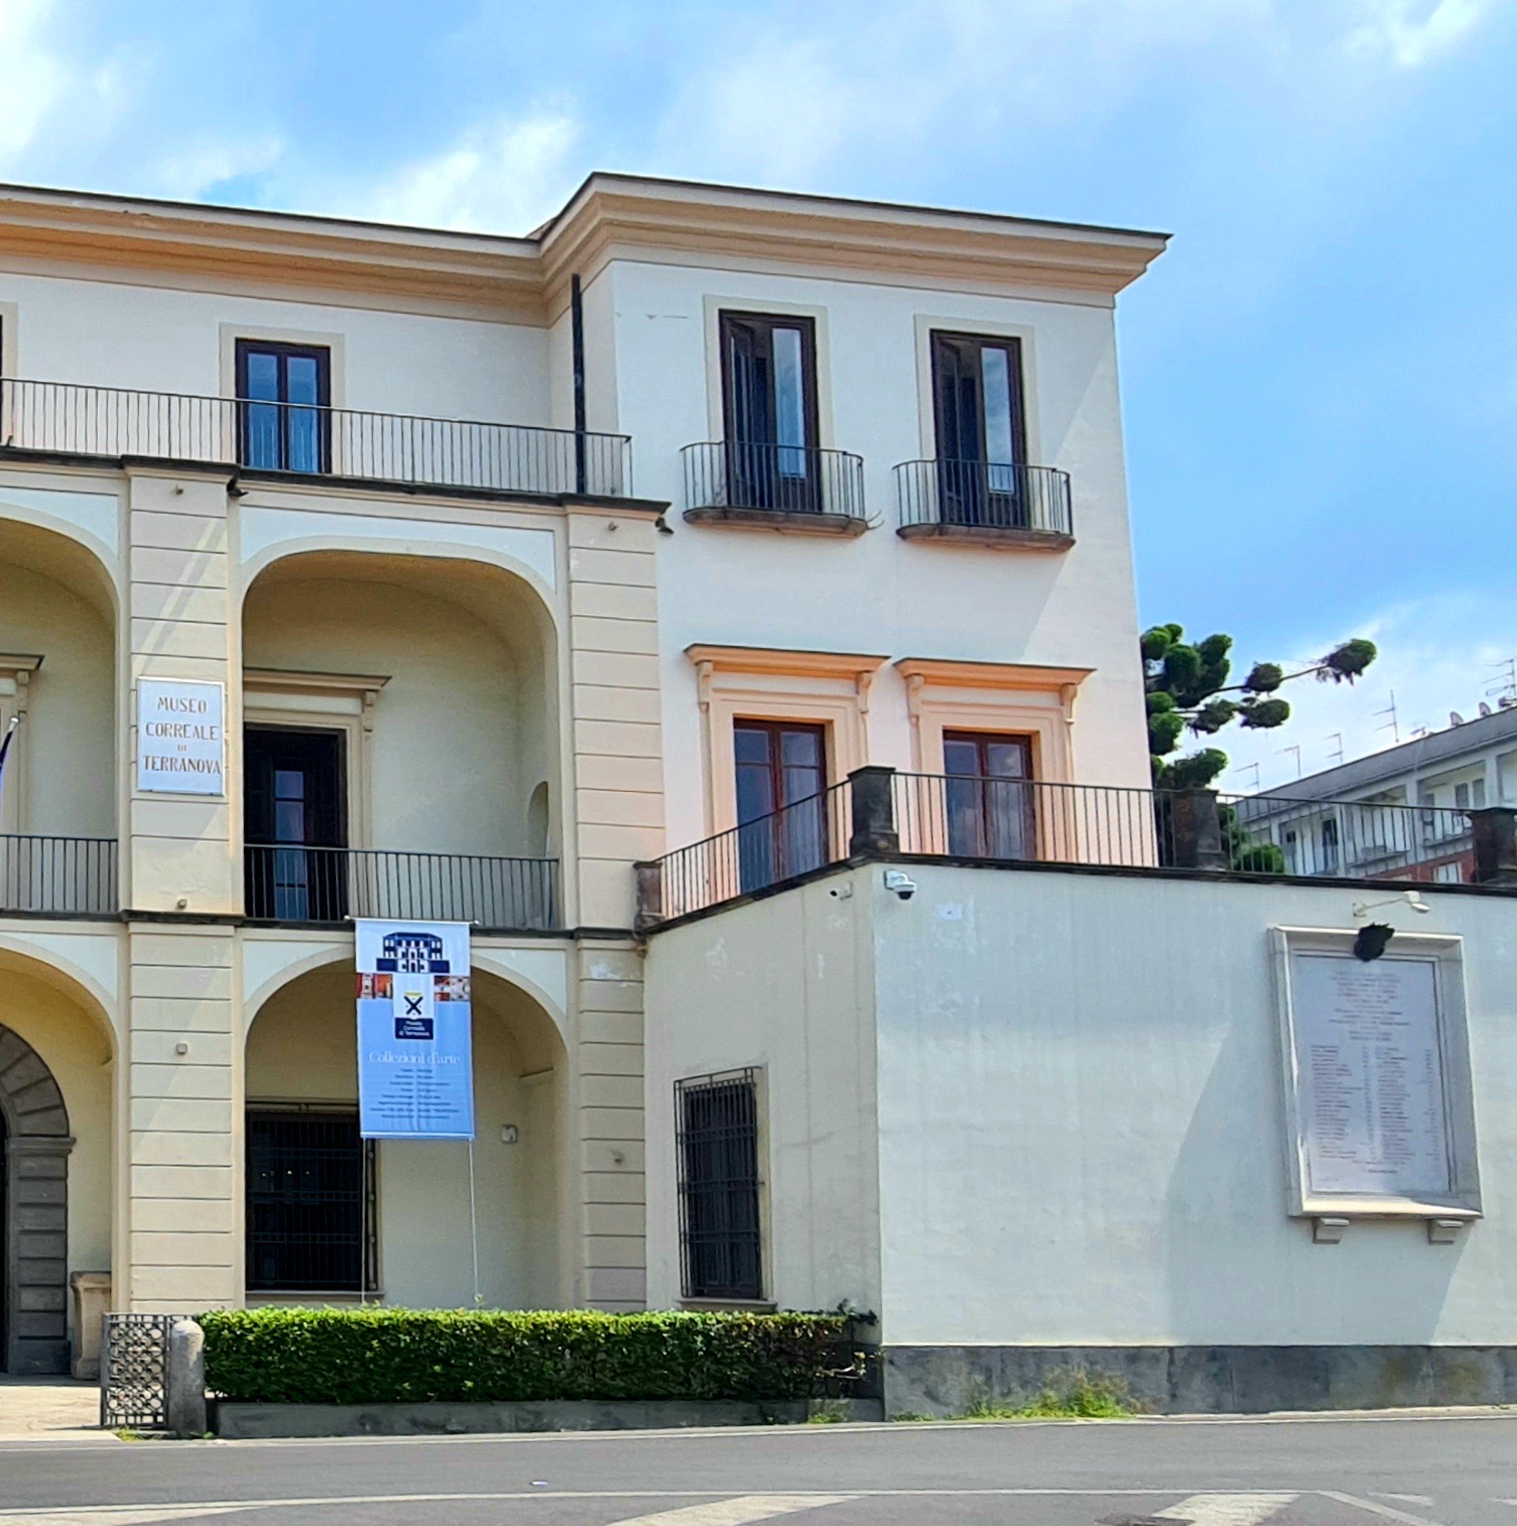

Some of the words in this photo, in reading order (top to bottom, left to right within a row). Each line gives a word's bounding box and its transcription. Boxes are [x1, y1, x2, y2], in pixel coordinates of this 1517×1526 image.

[157, 696, 207, 713] MUSEO
[146, 722, 219, 741] CORREALE
[143, 755, 222, 775] TERRANOVA
[368, 1050, 425, 1064] Collezioni
[426, 1051, 460, 1065] d'arte
